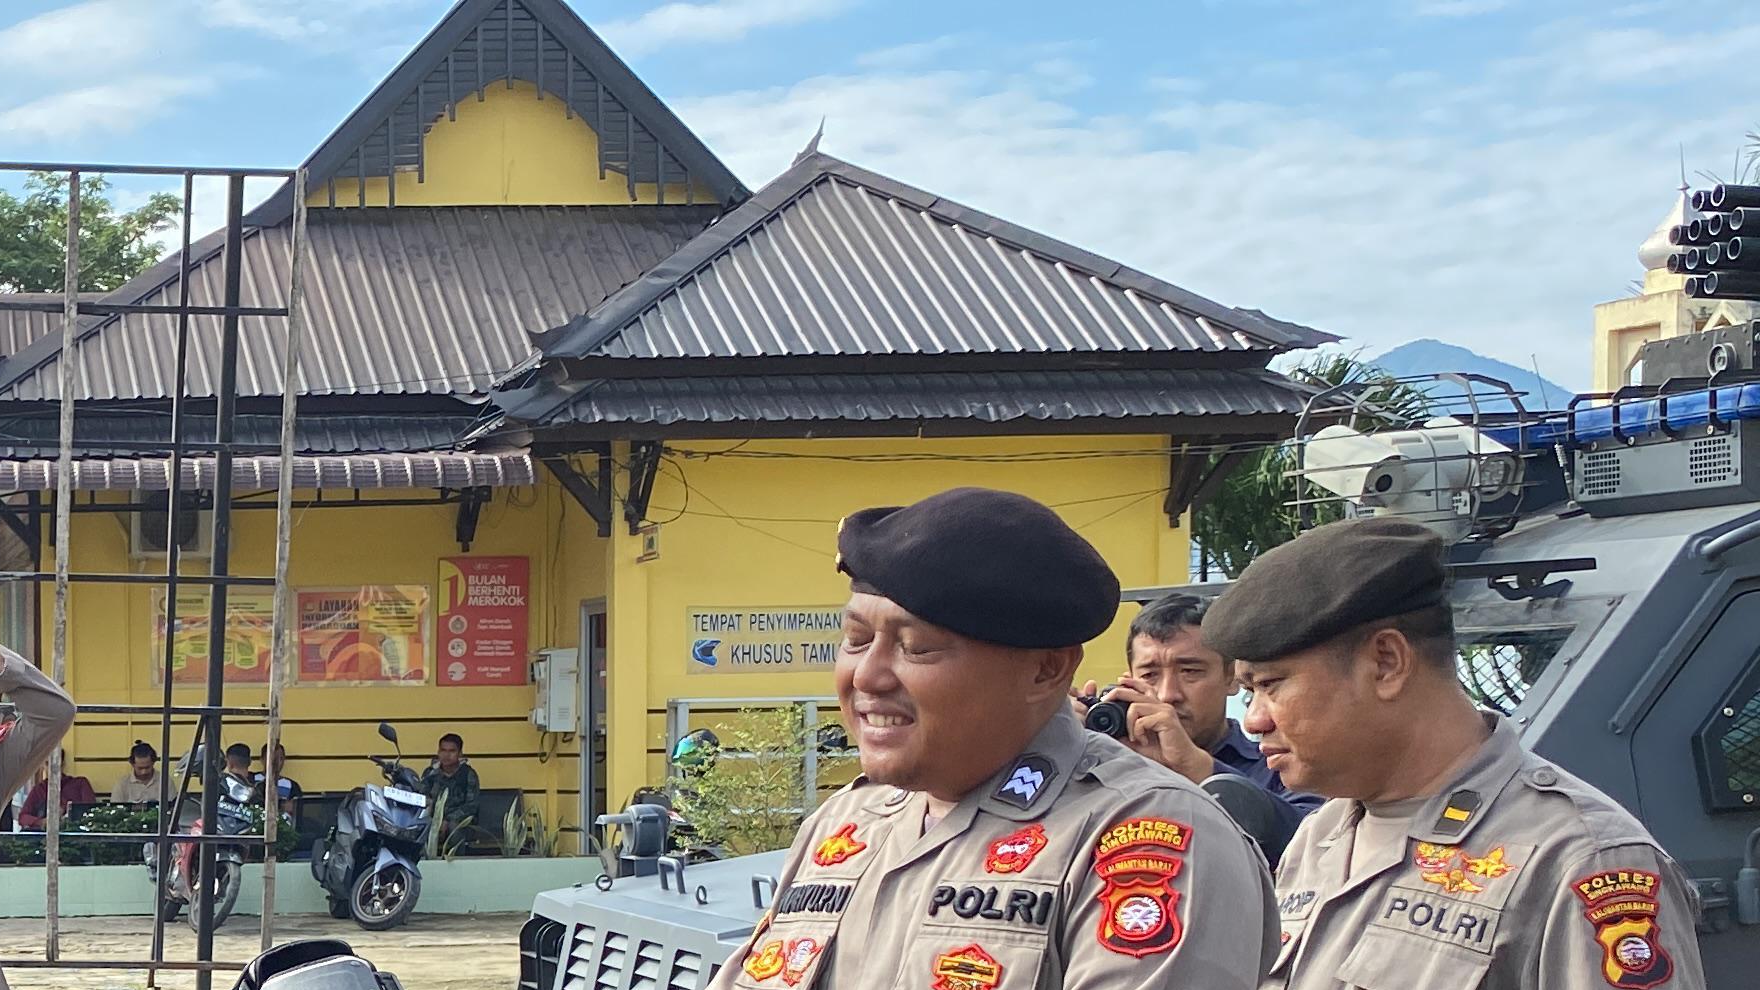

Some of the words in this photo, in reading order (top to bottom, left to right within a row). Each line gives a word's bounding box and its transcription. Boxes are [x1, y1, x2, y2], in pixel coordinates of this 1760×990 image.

[468, 575, 506, 585] BULAN
[468, 586, 520, 596] BERHENTI
[468, 596, 525, 606] MEROKOK
[693, 614, 742, 632] TEMPAT
[749, 612, 841, 632] PENYIMPANAN
[730, 643, 793, 664] KHUSUS
[1102, 821, 1178, 844] POLRES
[1579, 872, 1654, 894] POLRES
[928, 885, 1053, 926] POLRI
[1383, 897, 1489, 943] POLRI
